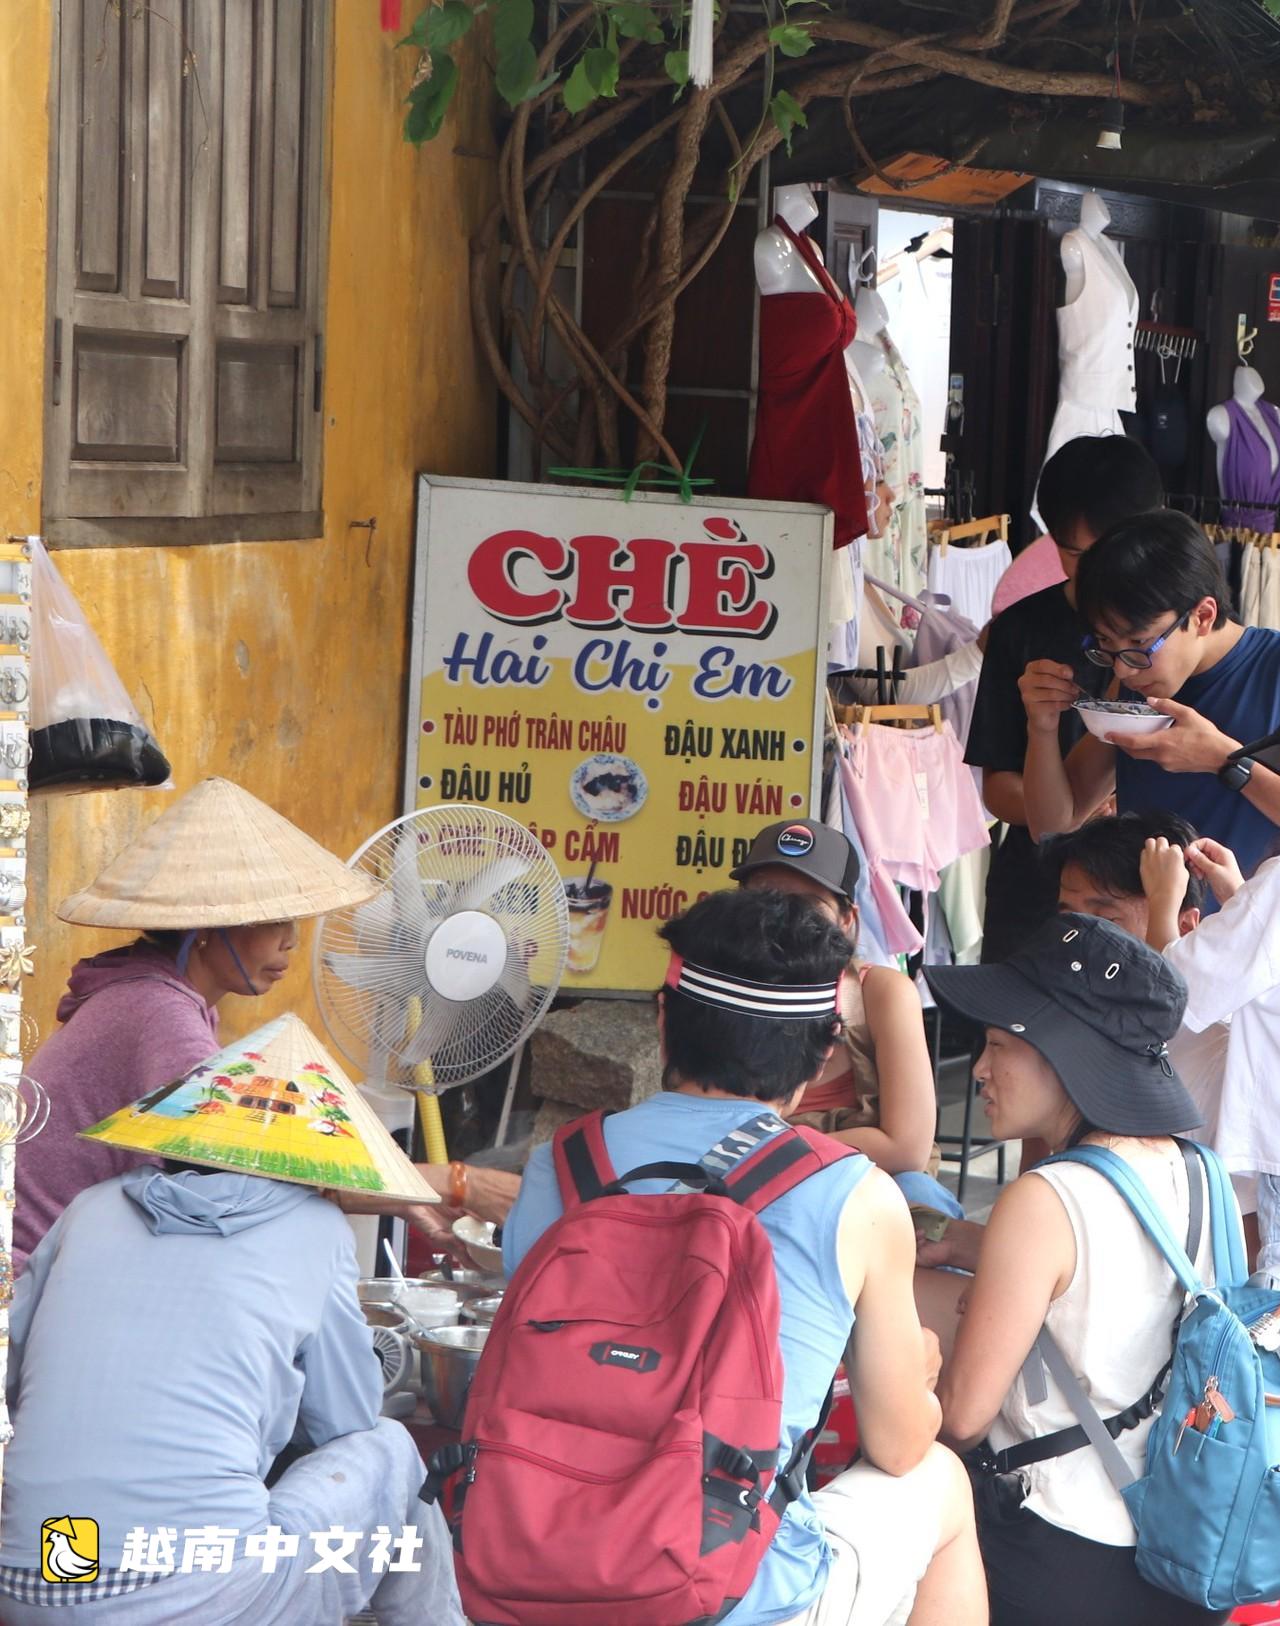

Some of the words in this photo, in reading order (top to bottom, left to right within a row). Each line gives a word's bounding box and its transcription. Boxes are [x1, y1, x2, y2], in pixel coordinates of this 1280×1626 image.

[467, 517, 776, 639] CHÈ
[443, 632, 549, 685] Hai
[574, 639, 670, 709] Chị
[694, 646, 791, 698] Em
[444, 707, 478, 746] TÀU
[483, 710, 521, 748] PHỚ
[526, 712, 572, 750] TRÂN
[578, 715, 627, 753] CHÂU
[664, 719, 713, 764] ĐẬU
[720, 728, 785, 761] XANH
[498, 761, 531, 804] HỦ
[679, 775, 727, 819] ĐẬU
[735, 778, 783, 816] VÁN
[565, 818, 620, 863] CẨM
[676, 830, 725, 874] ĐẬU
[621, 883, 688, 920] NƯỚC
[446, 948, 488, 964] POVENA
